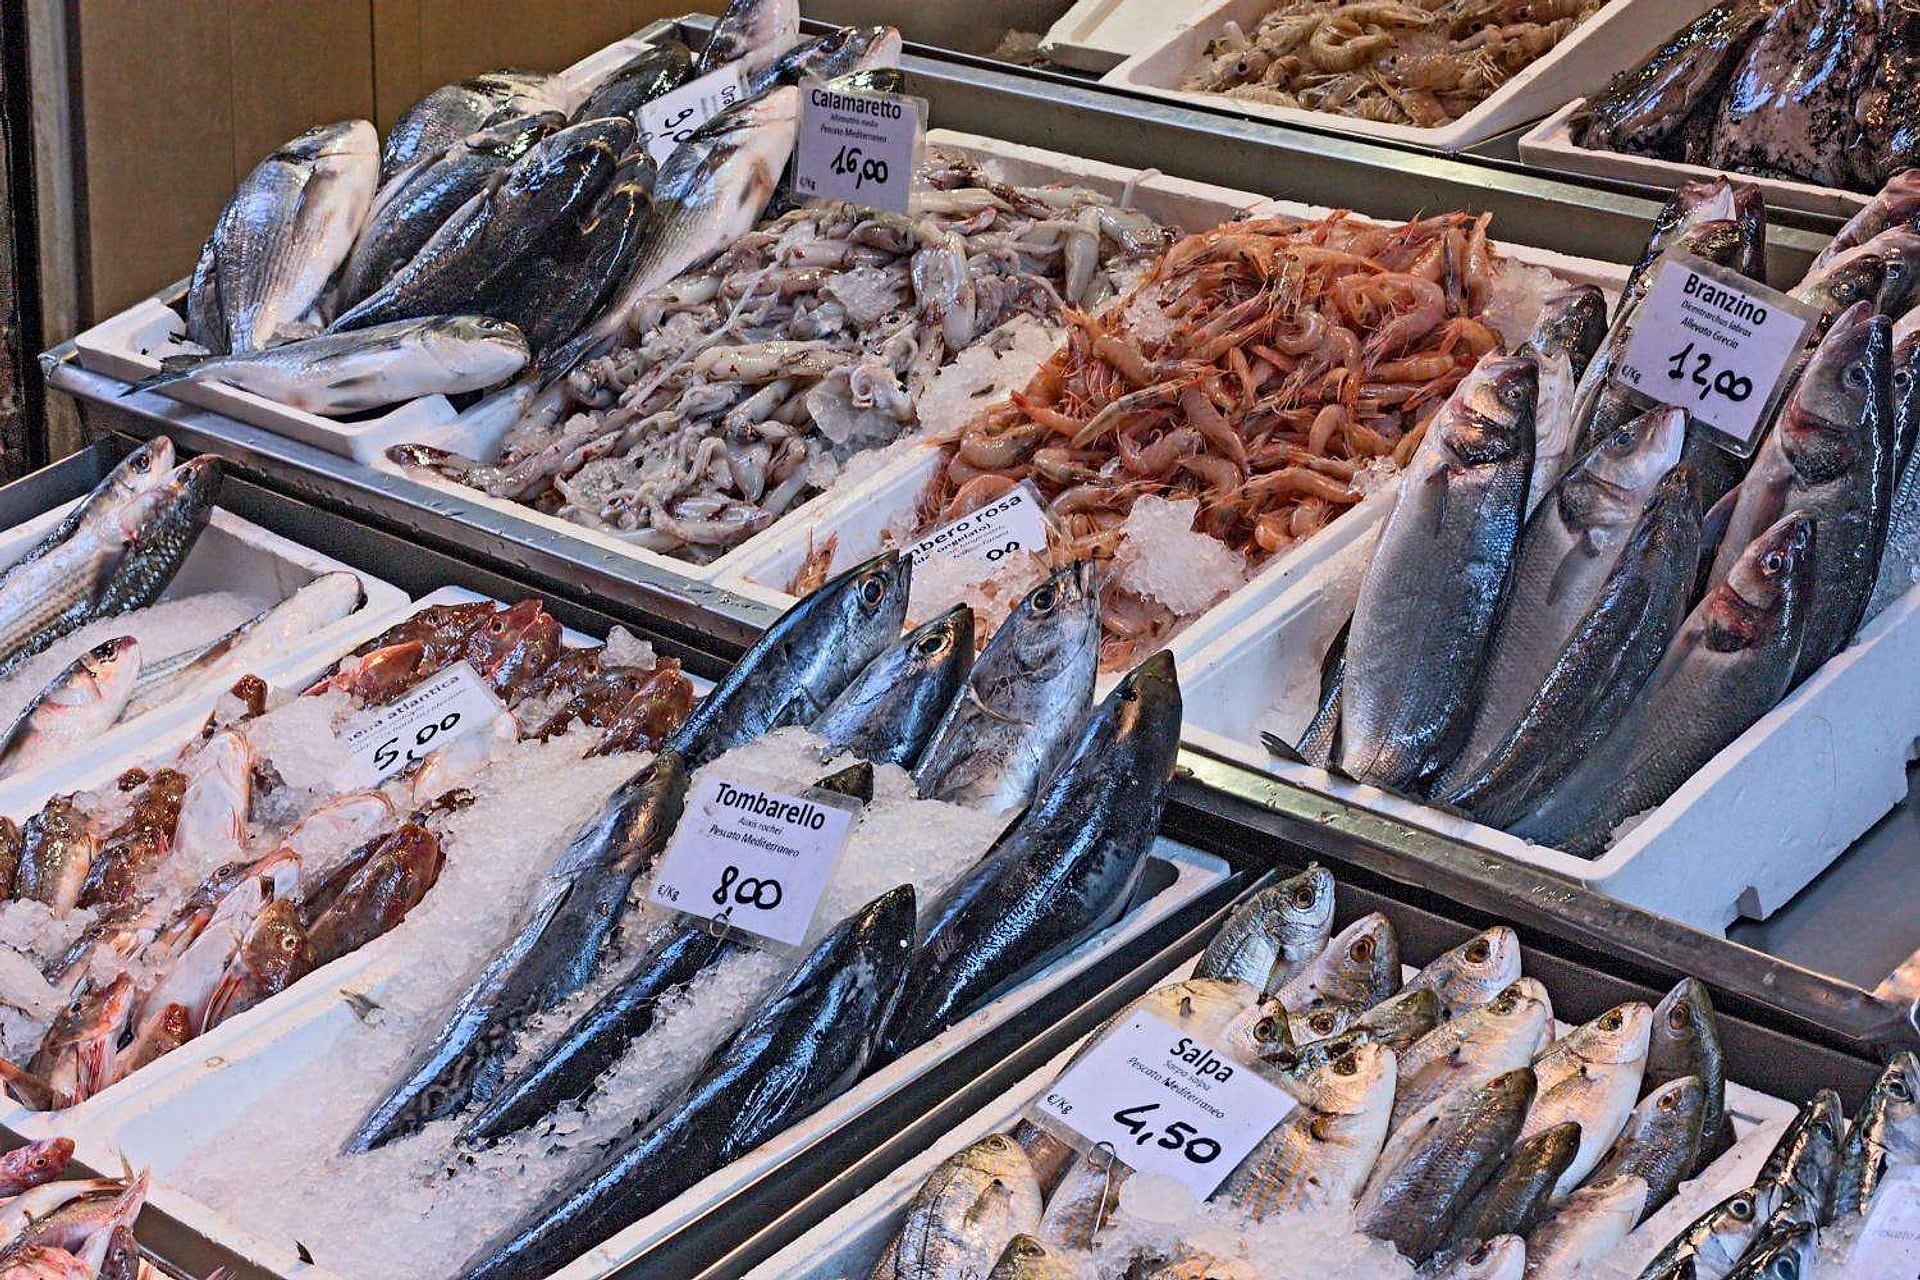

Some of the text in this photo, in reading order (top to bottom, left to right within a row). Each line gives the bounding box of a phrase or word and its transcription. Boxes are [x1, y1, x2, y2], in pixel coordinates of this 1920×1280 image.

[721, 85, 736, 105] Ora
[811, 89, 902, 119] Calamaretto
[659, 108, 694, 142] 9,0
[830, 145, 888, 190] 16,00
[1683, 273, 1767, 325] Branzino
[1680, 317, 1739, 350] Allevato Grecia
[1668, 343, 1753, 401] 12,00
[976, 496, 1022, 522] rosa
[373, 712, 461, 771] 5,00
[715, 783, 825, 830] Tombarello
[708, 824, 800, 858] Pescato Mediterraneo
[738, 817, 784, 836] Auxis rochei
[657, 883, 680, 902] €/Kg
[1163, 1059, 1212, 1092] Sarpa salpa
[1169, 1037, 1234, 1084] Salpa
[1046, 1094, 1073, 1115] €/Kg
[1127, 1056, 1225, 1119] Pescato Mediterraneo
[1113, 1103, 1221, 1164] 4,50
